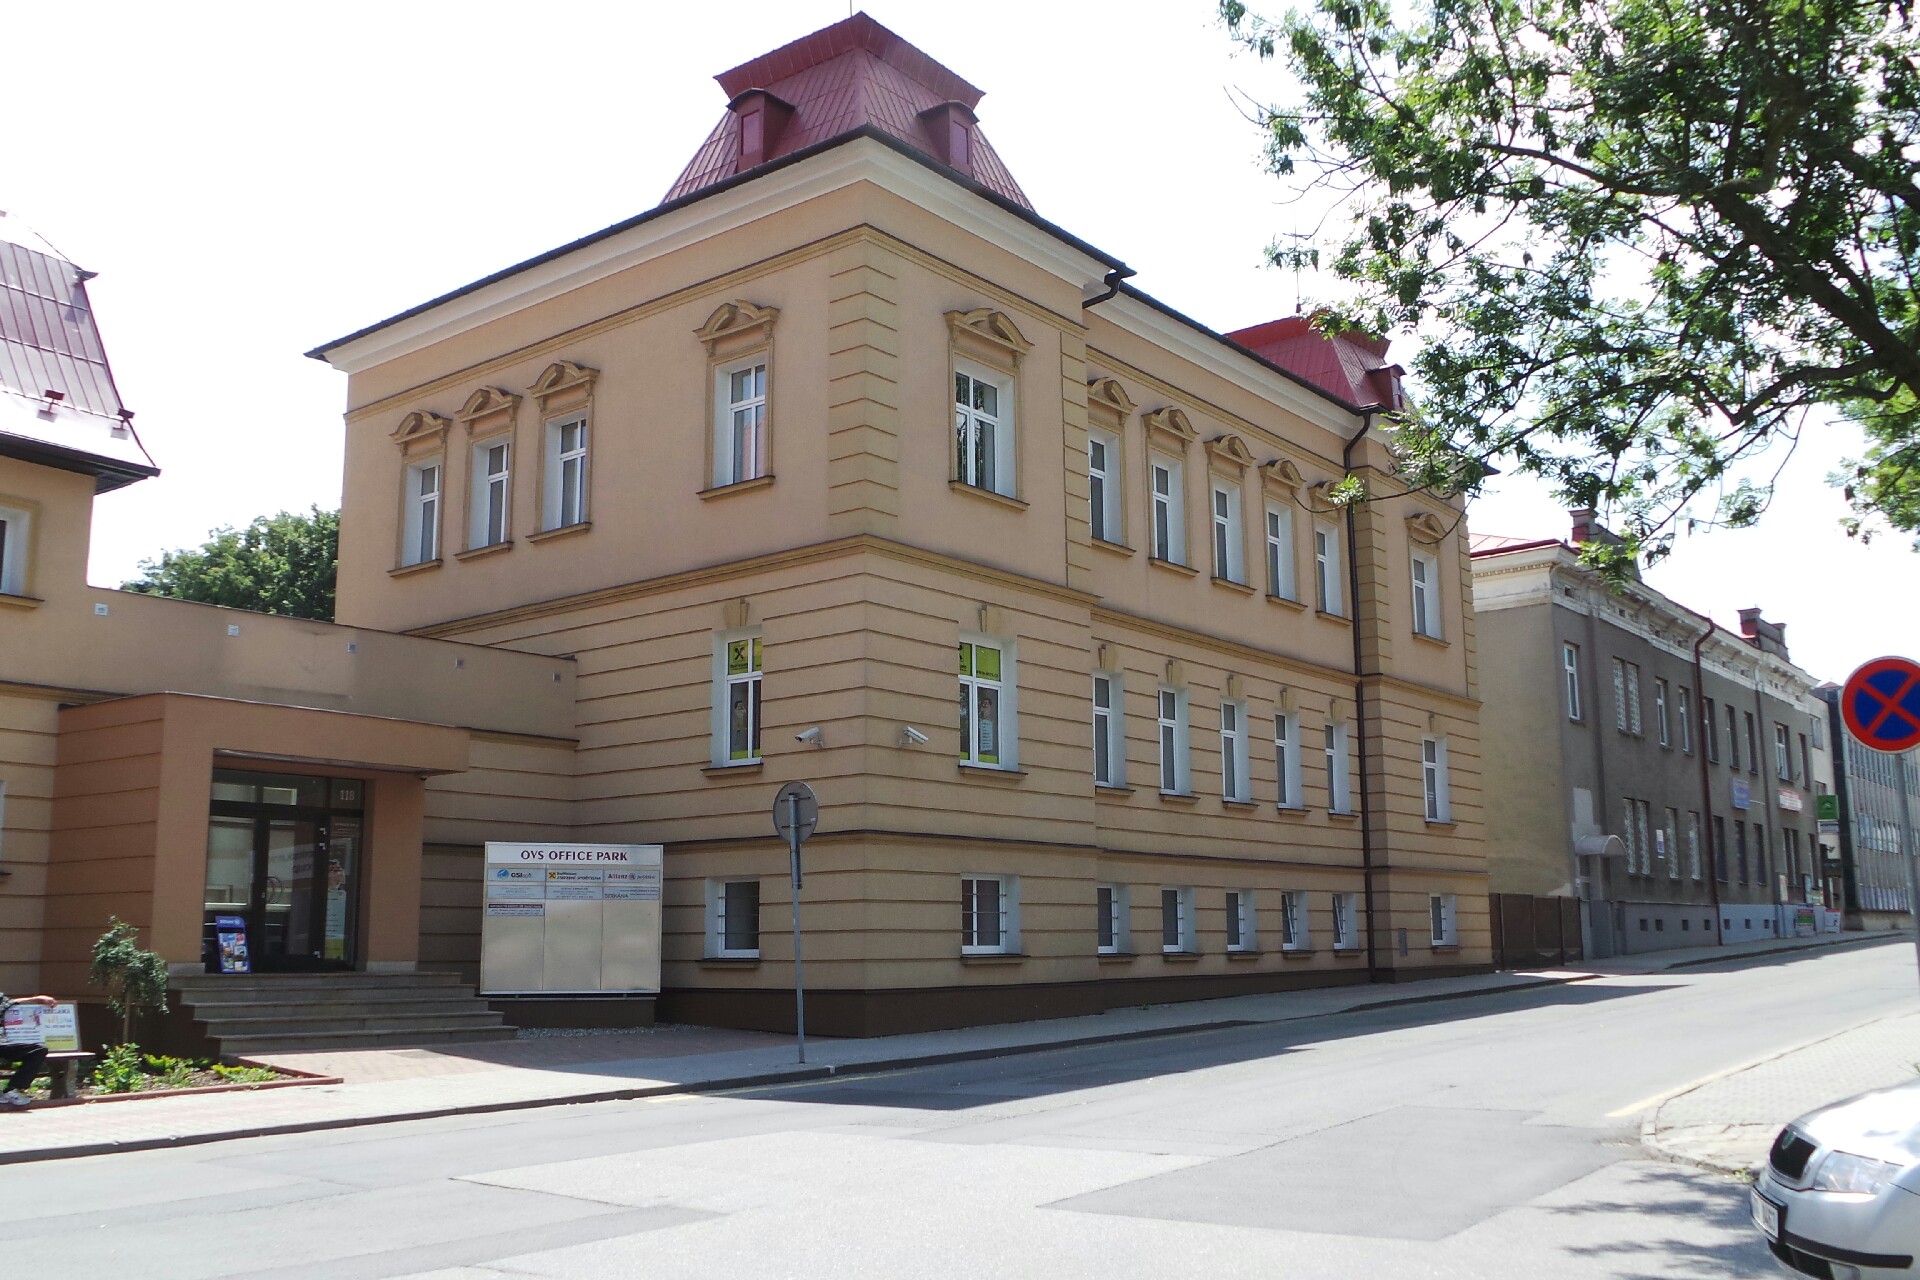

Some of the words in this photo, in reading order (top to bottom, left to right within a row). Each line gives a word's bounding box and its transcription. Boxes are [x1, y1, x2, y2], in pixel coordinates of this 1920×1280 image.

[520, 850, 544, 860] OYS
[548, 850, 593, 861] OFFICE
[596, 851, 628, 861] PARK
